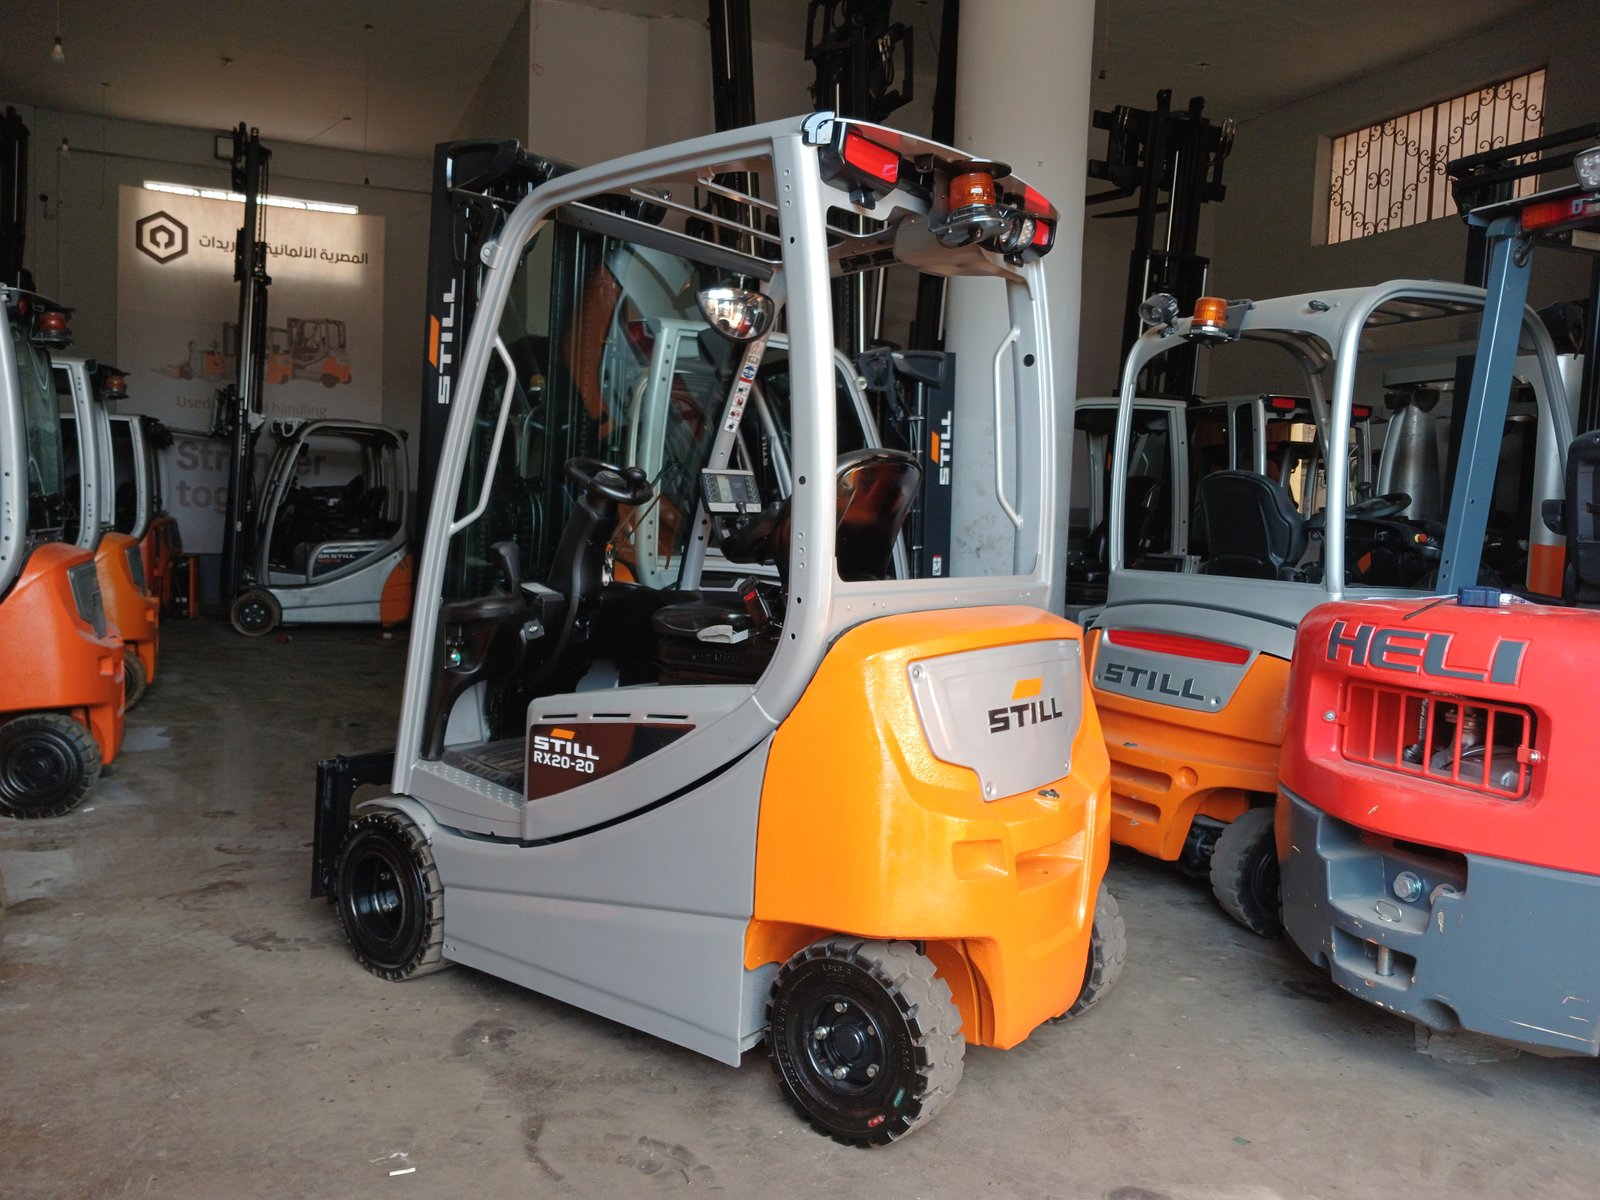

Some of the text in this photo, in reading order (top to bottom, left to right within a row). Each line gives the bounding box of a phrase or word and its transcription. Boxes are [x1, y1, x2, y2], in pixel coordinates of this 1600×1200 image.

[320, 248, 369, 265] المصرية
[437, 278, 456, 405] STILL
[176, 396, 210, 409] Used
[271, 403, 328, 417] handling
[176, 441, 327, 476] Strner
[939, 411, 952, 486] STILL
[1326, 619, 1533, 687] HELI
[1103, 663, 1205, 702] STILL
[987, 697, 1063, 734] STILL
[533, 735, 600, 761] STILL
[533, 750, 595, 774] RX20-20
